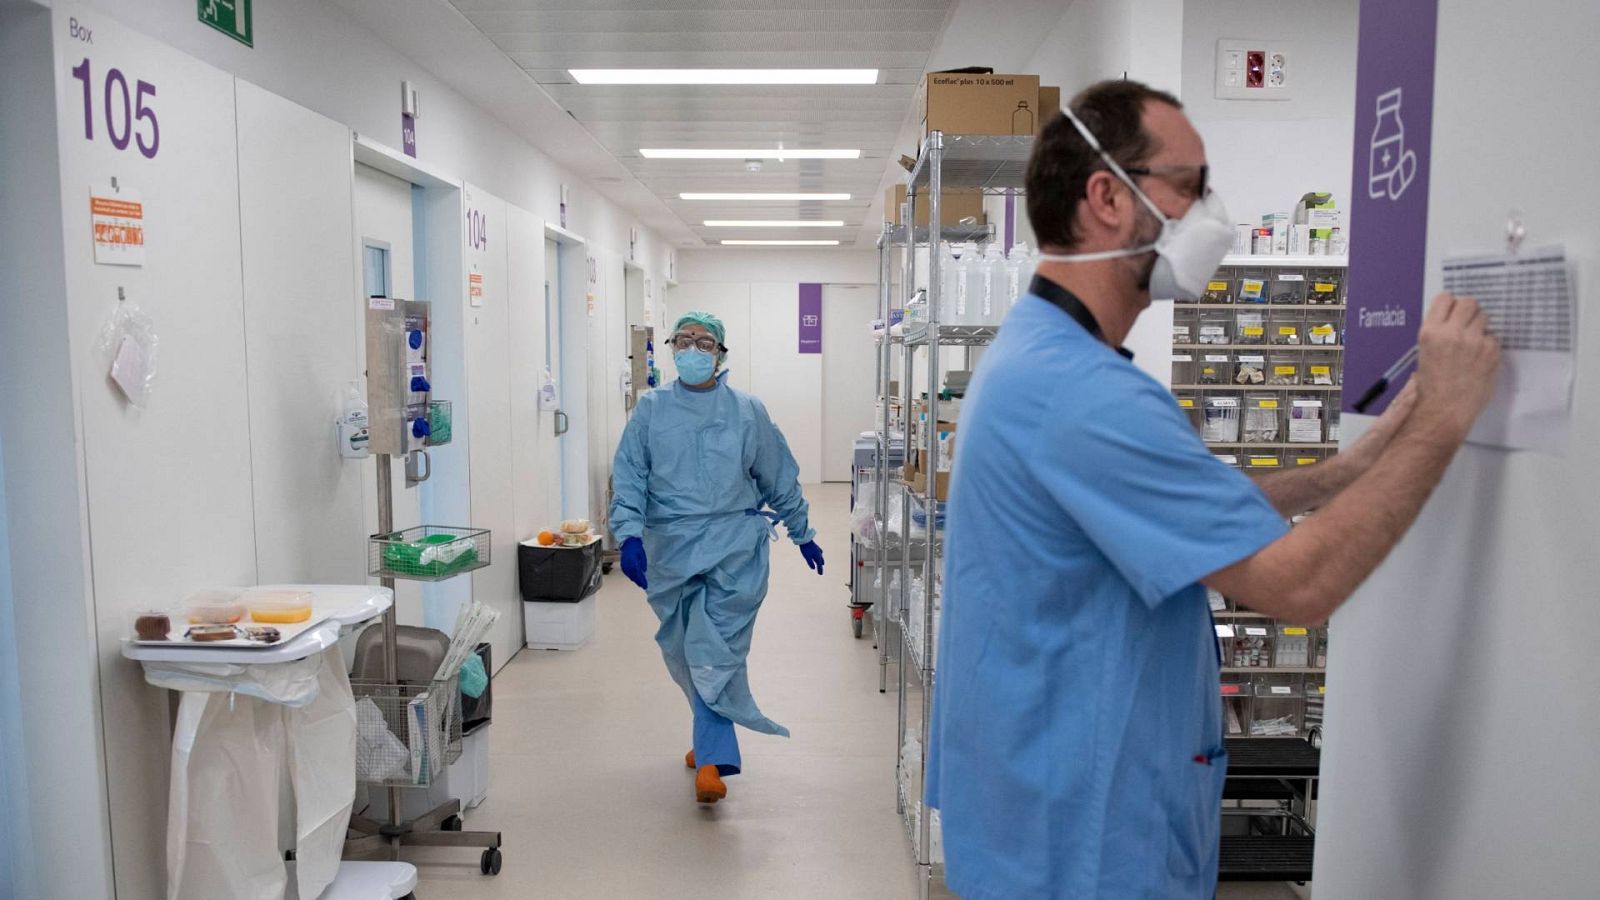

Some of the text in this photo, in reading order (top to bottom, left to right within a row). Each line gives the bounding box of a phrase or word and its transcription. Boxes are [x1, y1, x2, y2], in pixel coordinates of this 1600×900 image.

[69, 16, 94, 44] Box
[960, 78, 973, 86] plus
[72, 57, 160, 159] 105
[403, 128, 414, 147] 104
[466, 207, 487, 252] 104
[1359, 303, 1406, 328] Farmàcia
